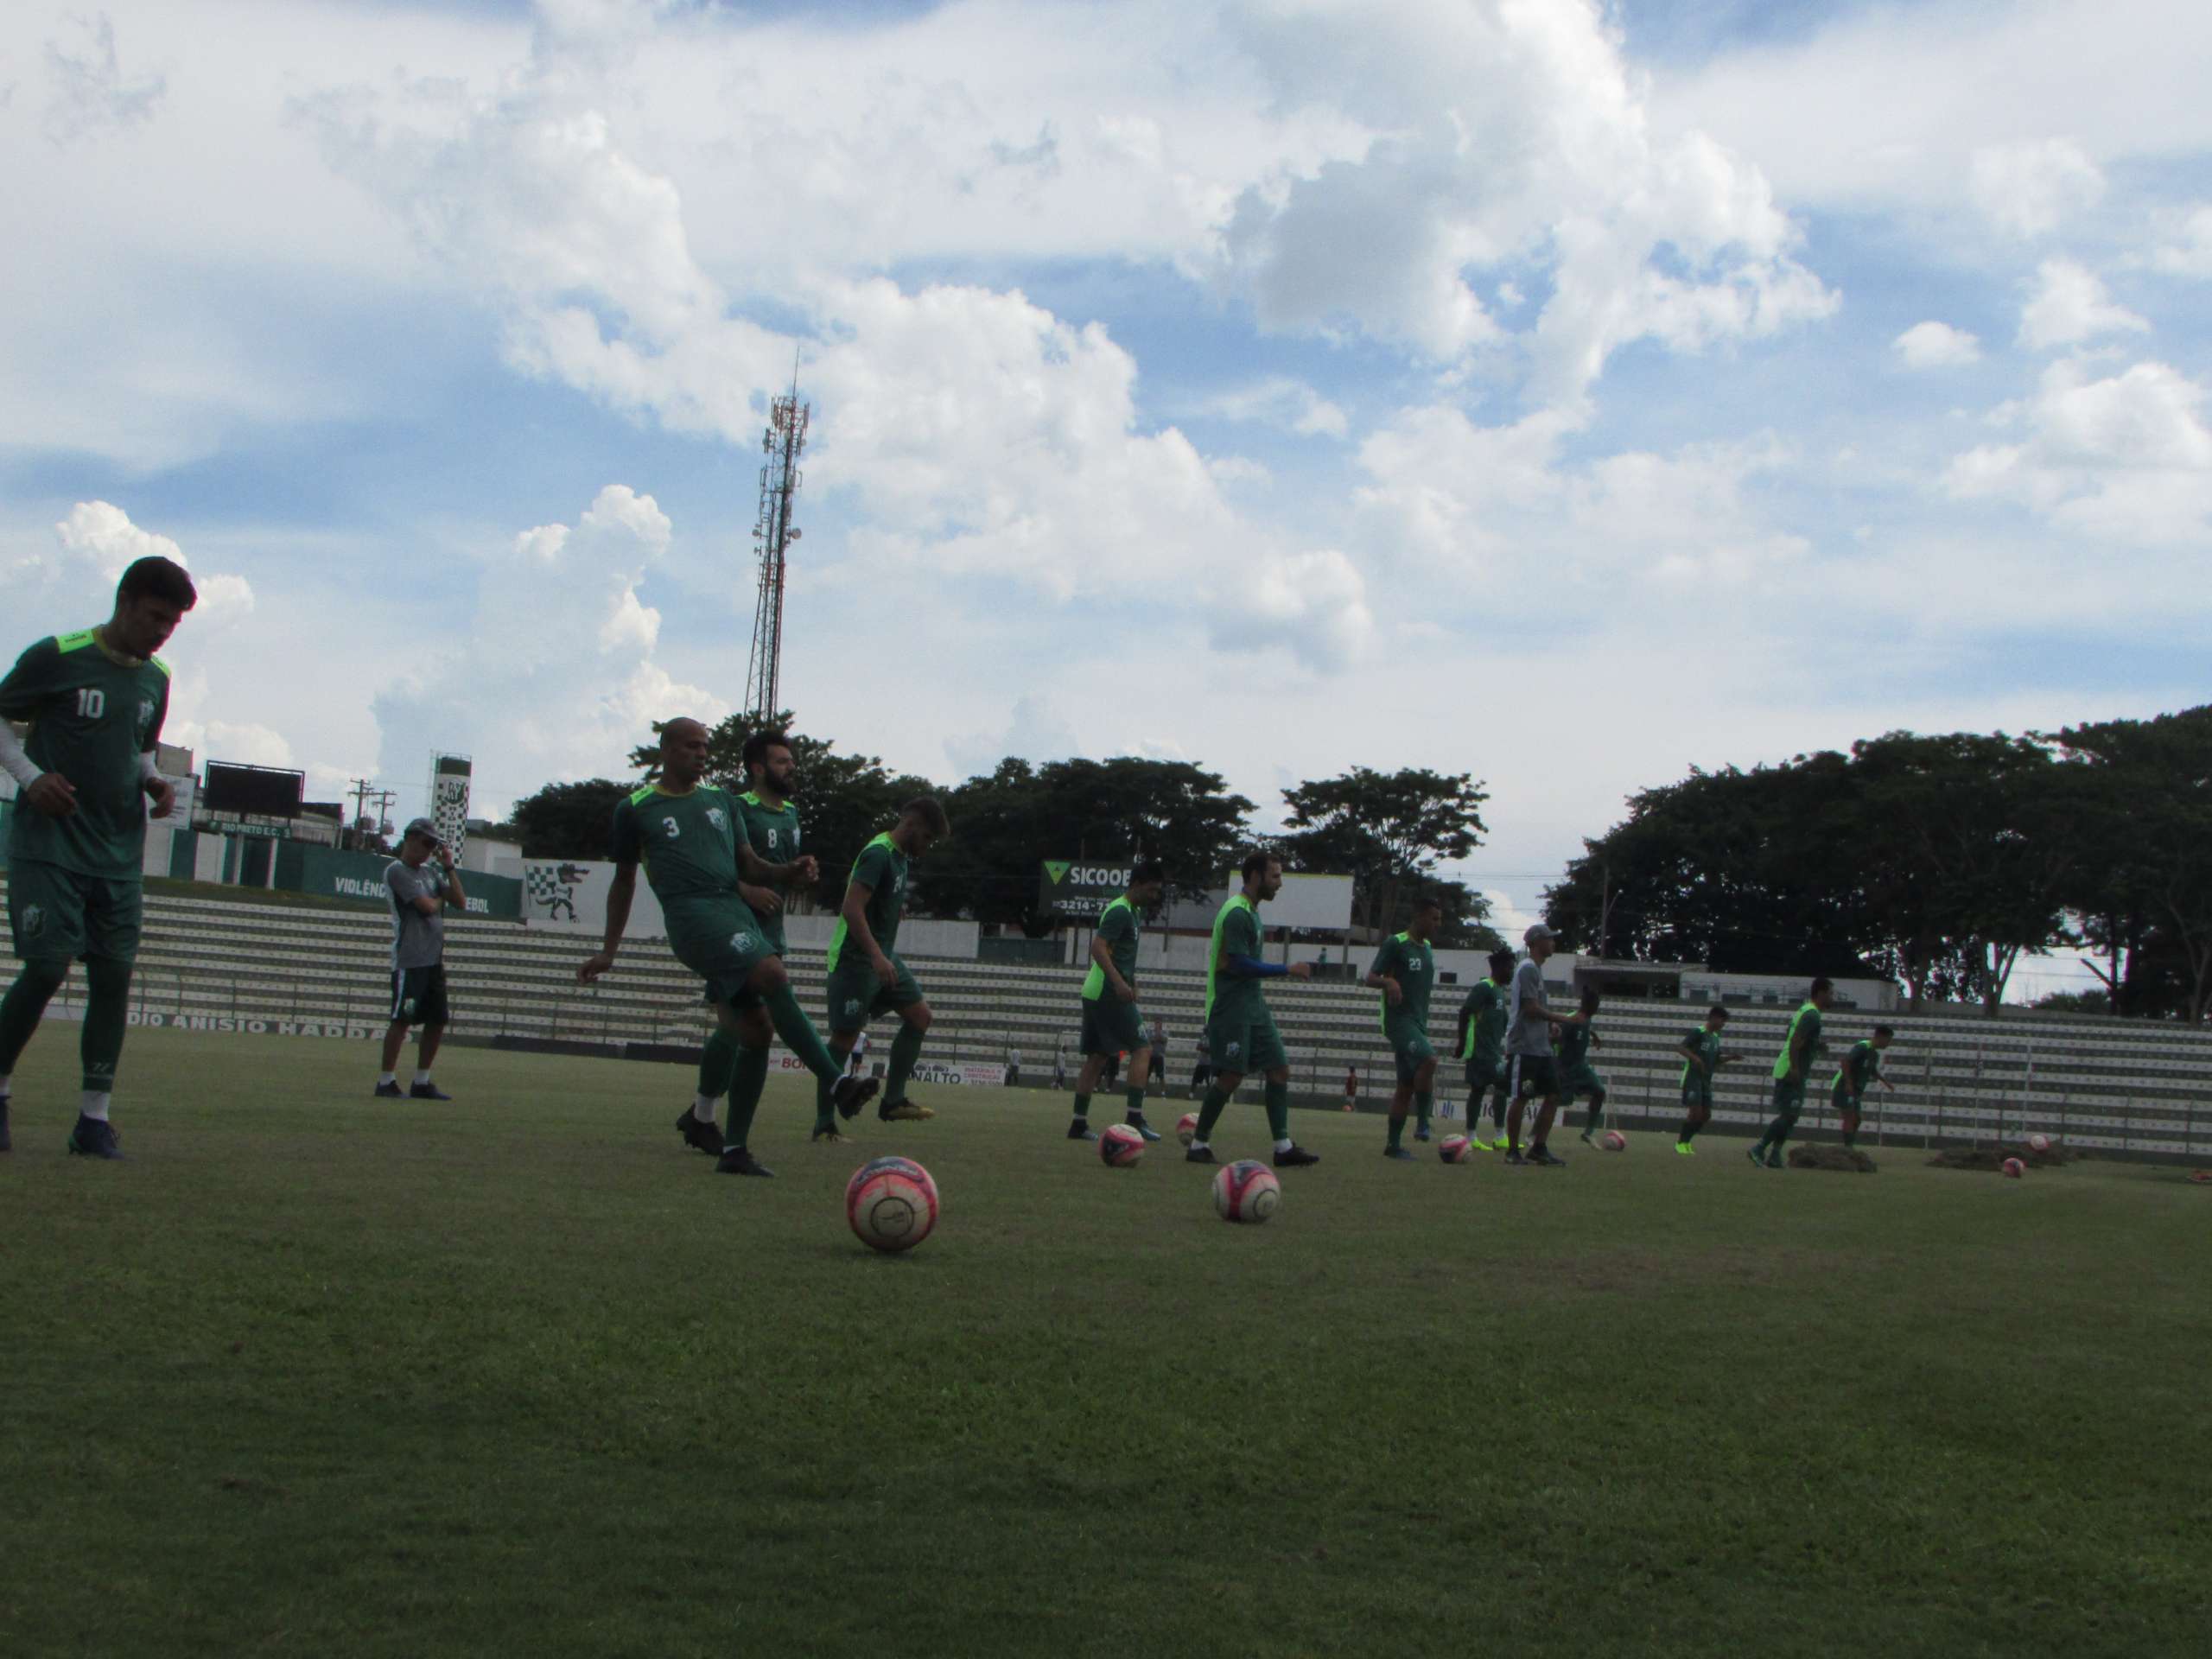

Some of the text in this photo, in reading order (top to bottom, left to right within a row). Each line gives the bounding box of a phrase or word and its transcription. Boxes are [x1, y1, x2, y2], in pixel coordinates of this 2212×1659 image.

[77, 688, 105, 719] 10
[221, 822, 236, 832] RIO
[237, 823, 263, 835] PRETO
[663, 816, 680, 837] 3
[767, 828, 777, 849] 8
[334, 876, 490, 913] VIOLÊNC EBOL
[1408, 957, 1422, 971] 23
[171, 1014, 268, 1034] ANISIO
[913, 1071, 962, 1084] NALTO
